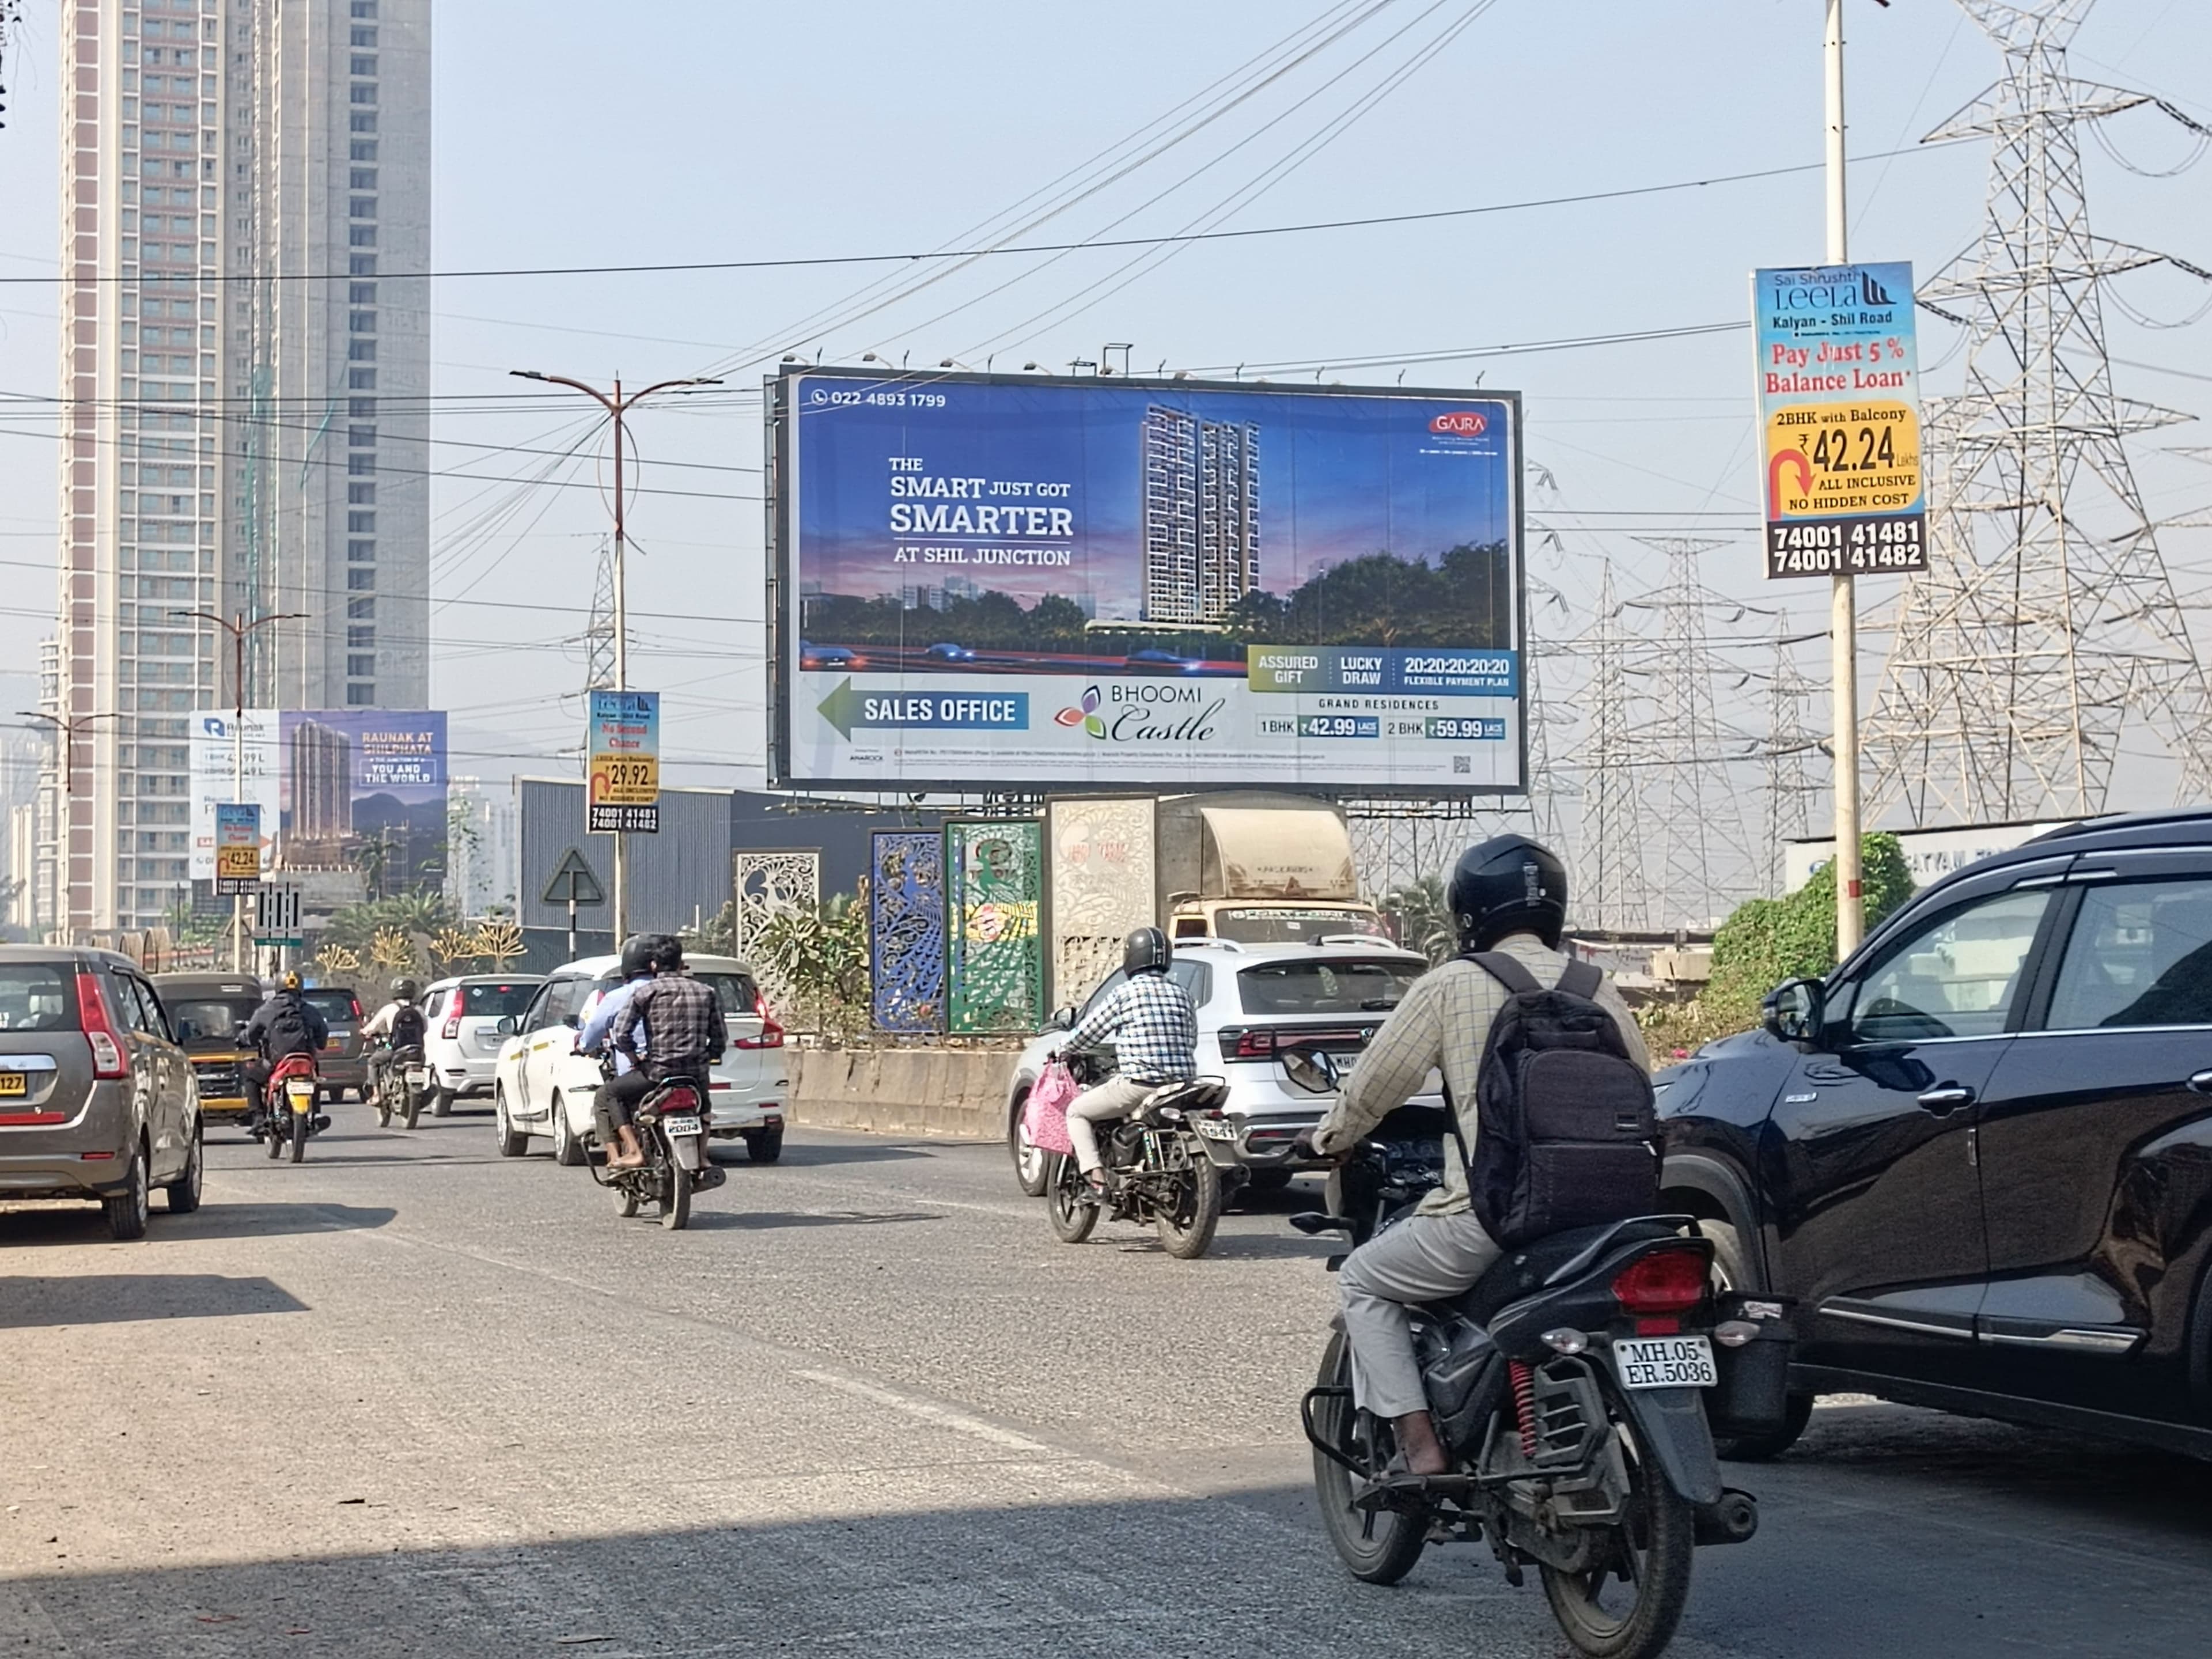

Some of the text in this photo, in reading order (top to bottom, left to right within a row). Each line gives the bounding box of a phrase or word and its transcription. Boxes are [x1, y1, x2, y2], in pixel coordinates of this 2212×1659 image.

[1775, 274, 1796, 286] Sai
[1773, 316, 1816, 330] Kalyan
[1831, 313, 1855, 326] Shil
[1860, 311, 1892, 324] Road
[1771, 337, 1904, 368] Pay Just 5 %
[1766, 372, 1847, 393] Balance
[831, 392, 946, 407] 022 4893 1799
[1777, 408, 1906, 426] 2BHK with Balcony
[889, 457, 923, 471] THE
[890, 476, 1070, 498] SMART JUST GOT
[1819, 475, 1916, 490] ALL INCLUSIVE
[1789, 493, 1909, 510] NO HIDDEN COST
[890, 503, 1074, 536] SMARTER
[1774, 521, 1919, 550] 74001 41481
[893, 547, 1071, 566] AT SHIL JUNCTION
[1774, 544, 1922, 572] 74001 41482
[1258, 656, 1318, 669] ASSURED
[1340, 657, 1382, 670] LUCKY
[1405, 657, 1510, 675] 20:20:20:20:20
[1275, 671, 1303, 684] GIFT
[1343, 671, 1381, 684] DRAW
[1404, 676, 1509, 687] FLEXIBLE PAYMENT PLAN
[1112, 685, 1201, 703] BHOOMI
[865, 698, 1016, 721] SALES OFFICE
[1319, 698, 1439, 710] GRAND RESIDENCES
[1112, 697, 1226, 741] Castle
[1399, 722, 1424, 735] BHK
[362, 732, 434, 743] RAUNAK AT
[372, 764, 421, 774] YOU AND
[366, 773, 430, 783] THE WORLD
[592, 807, 623, 818] 74001
[592, 818, 622, 828] 74001
[1630, 1342, 1699, 1363] MH.05
[1625, 1362, 1712, 1384] ER.5036
